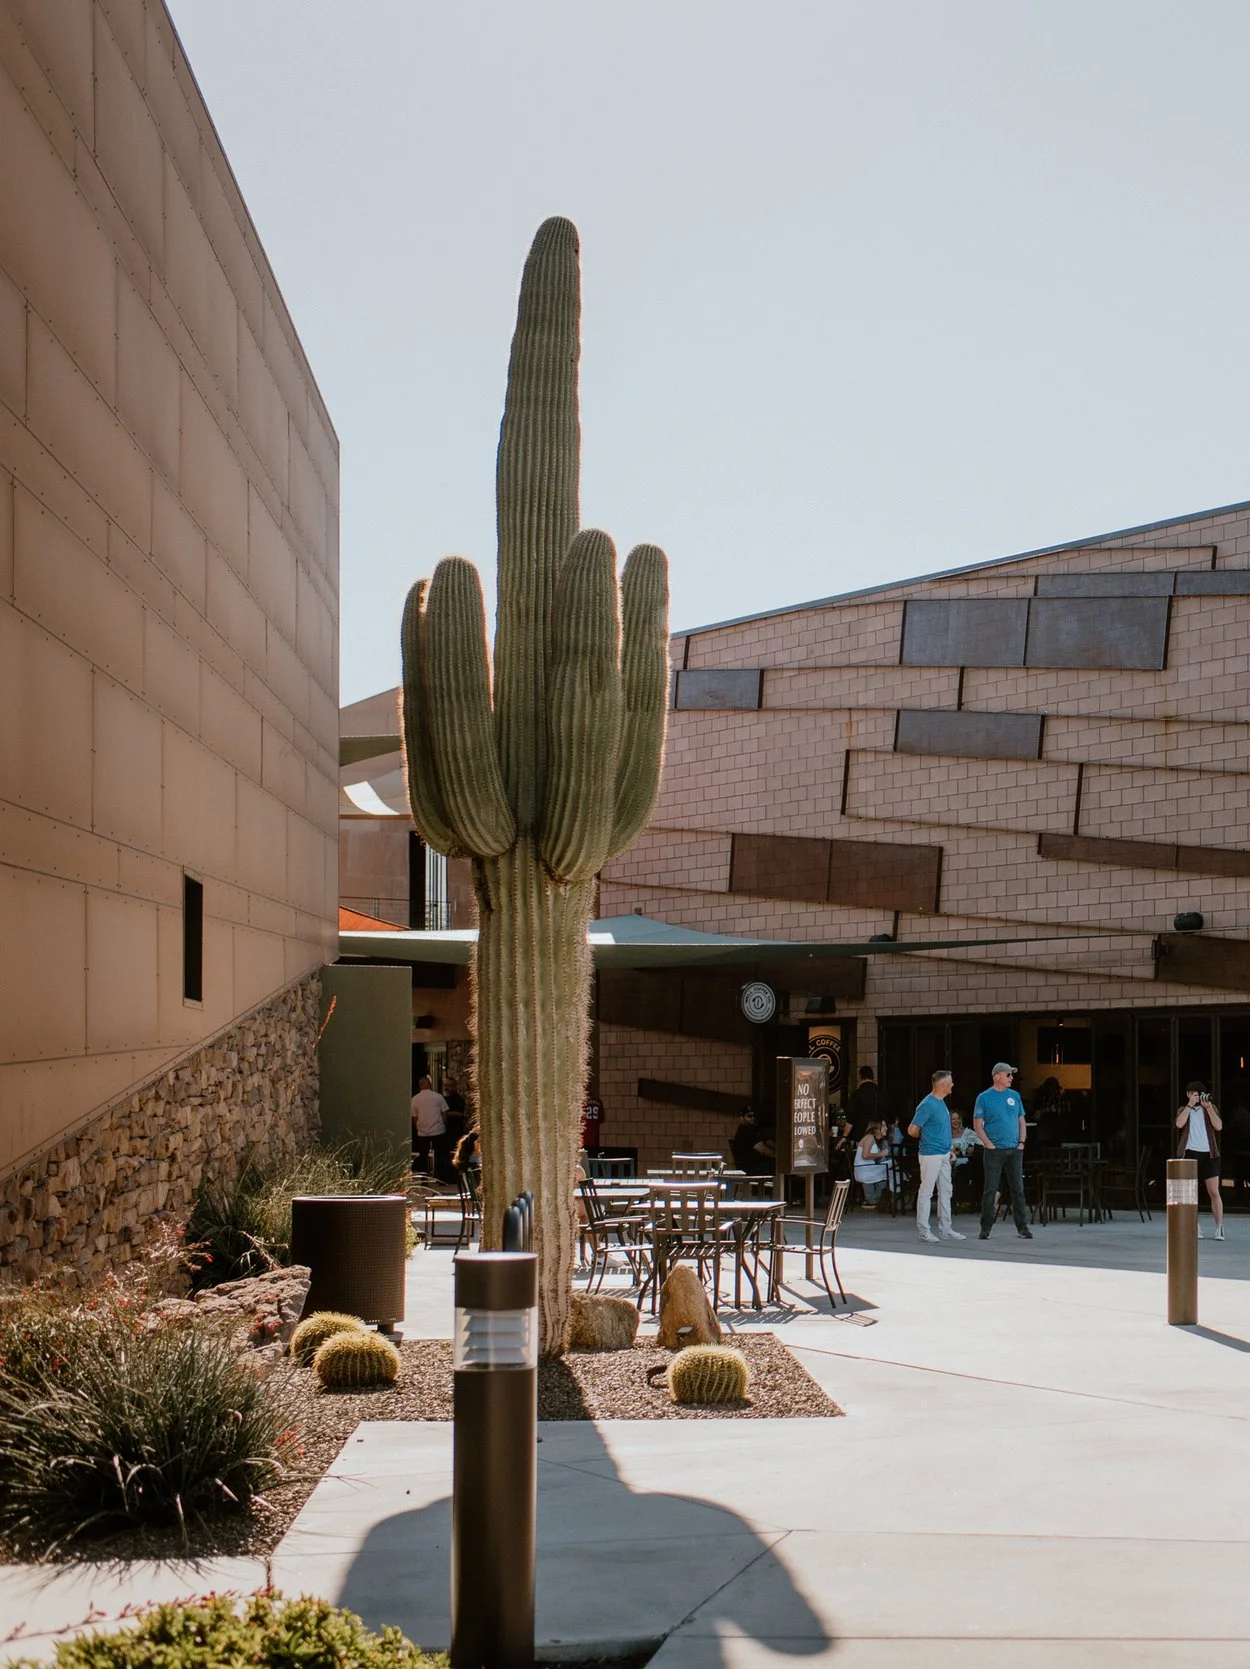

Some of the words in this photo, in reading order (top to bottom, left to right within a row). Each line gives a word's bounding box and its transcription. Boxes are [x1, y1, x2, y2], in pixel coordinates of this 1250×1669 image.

[753, 986, 769, 995] COFFEE
[816, 1038, 841, 1052] COFFEE
[797, 1083, 810, 1096] NO
[794, 1098, 817, 1109] ERFECT
[794, 1111, 816, 1123] EOPLE
[794, 1125, 817, 1136] LOWED
